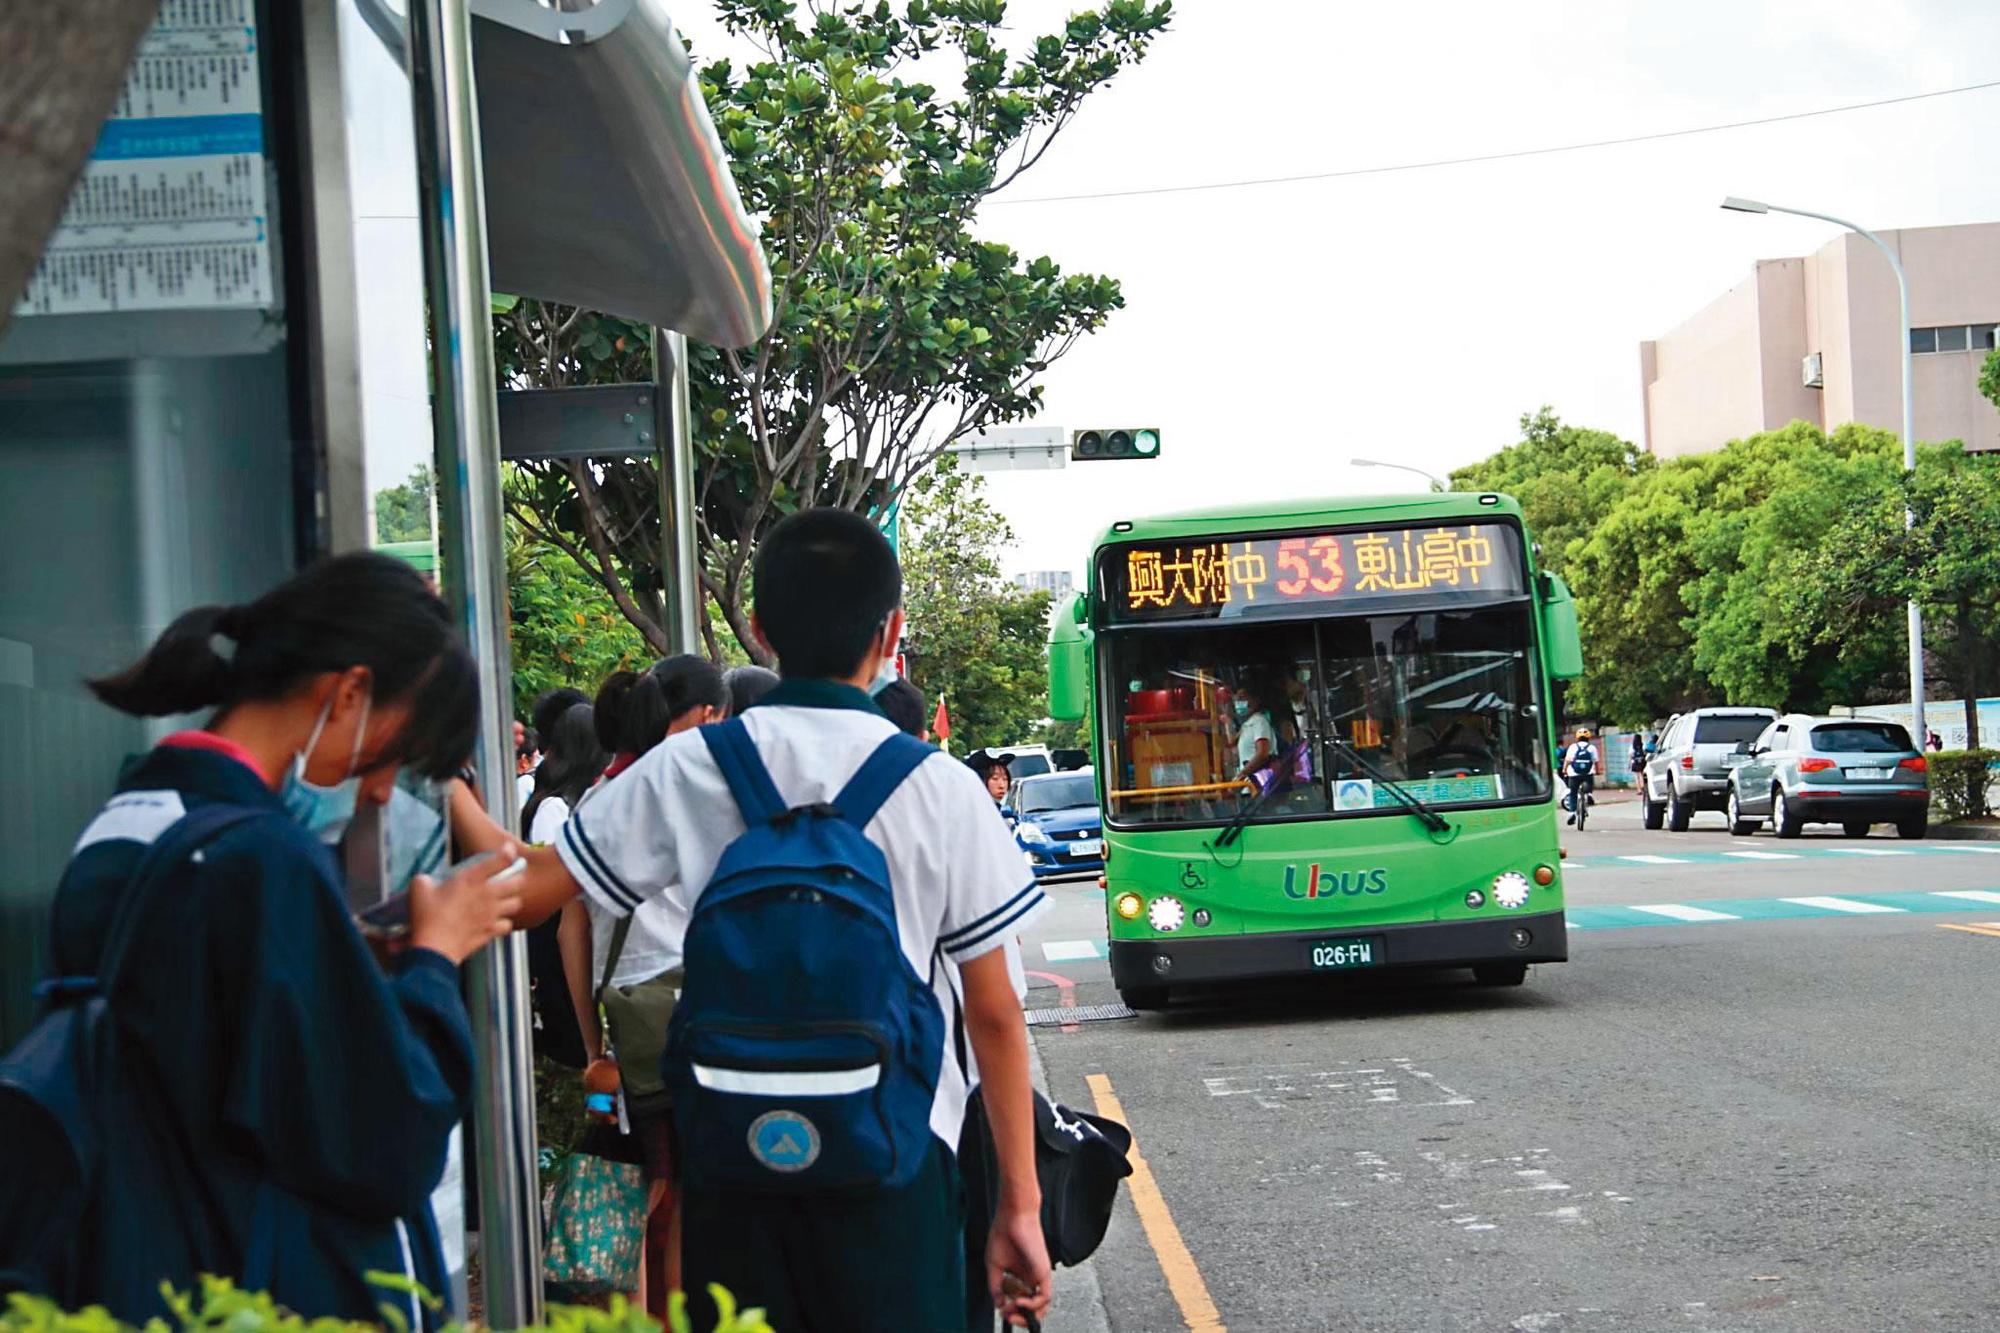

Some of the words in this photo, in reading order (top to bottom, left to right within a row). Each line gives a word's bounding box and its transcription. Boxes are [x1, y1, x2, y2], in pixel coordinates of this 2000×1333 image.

[1128, 542, 1266, 608] 興大附中
[1276, 536, 1345, 597] 53
[1352, 525, 1493, 591] 東山高中
[1313, 944, 1371, 966] 026-FW
